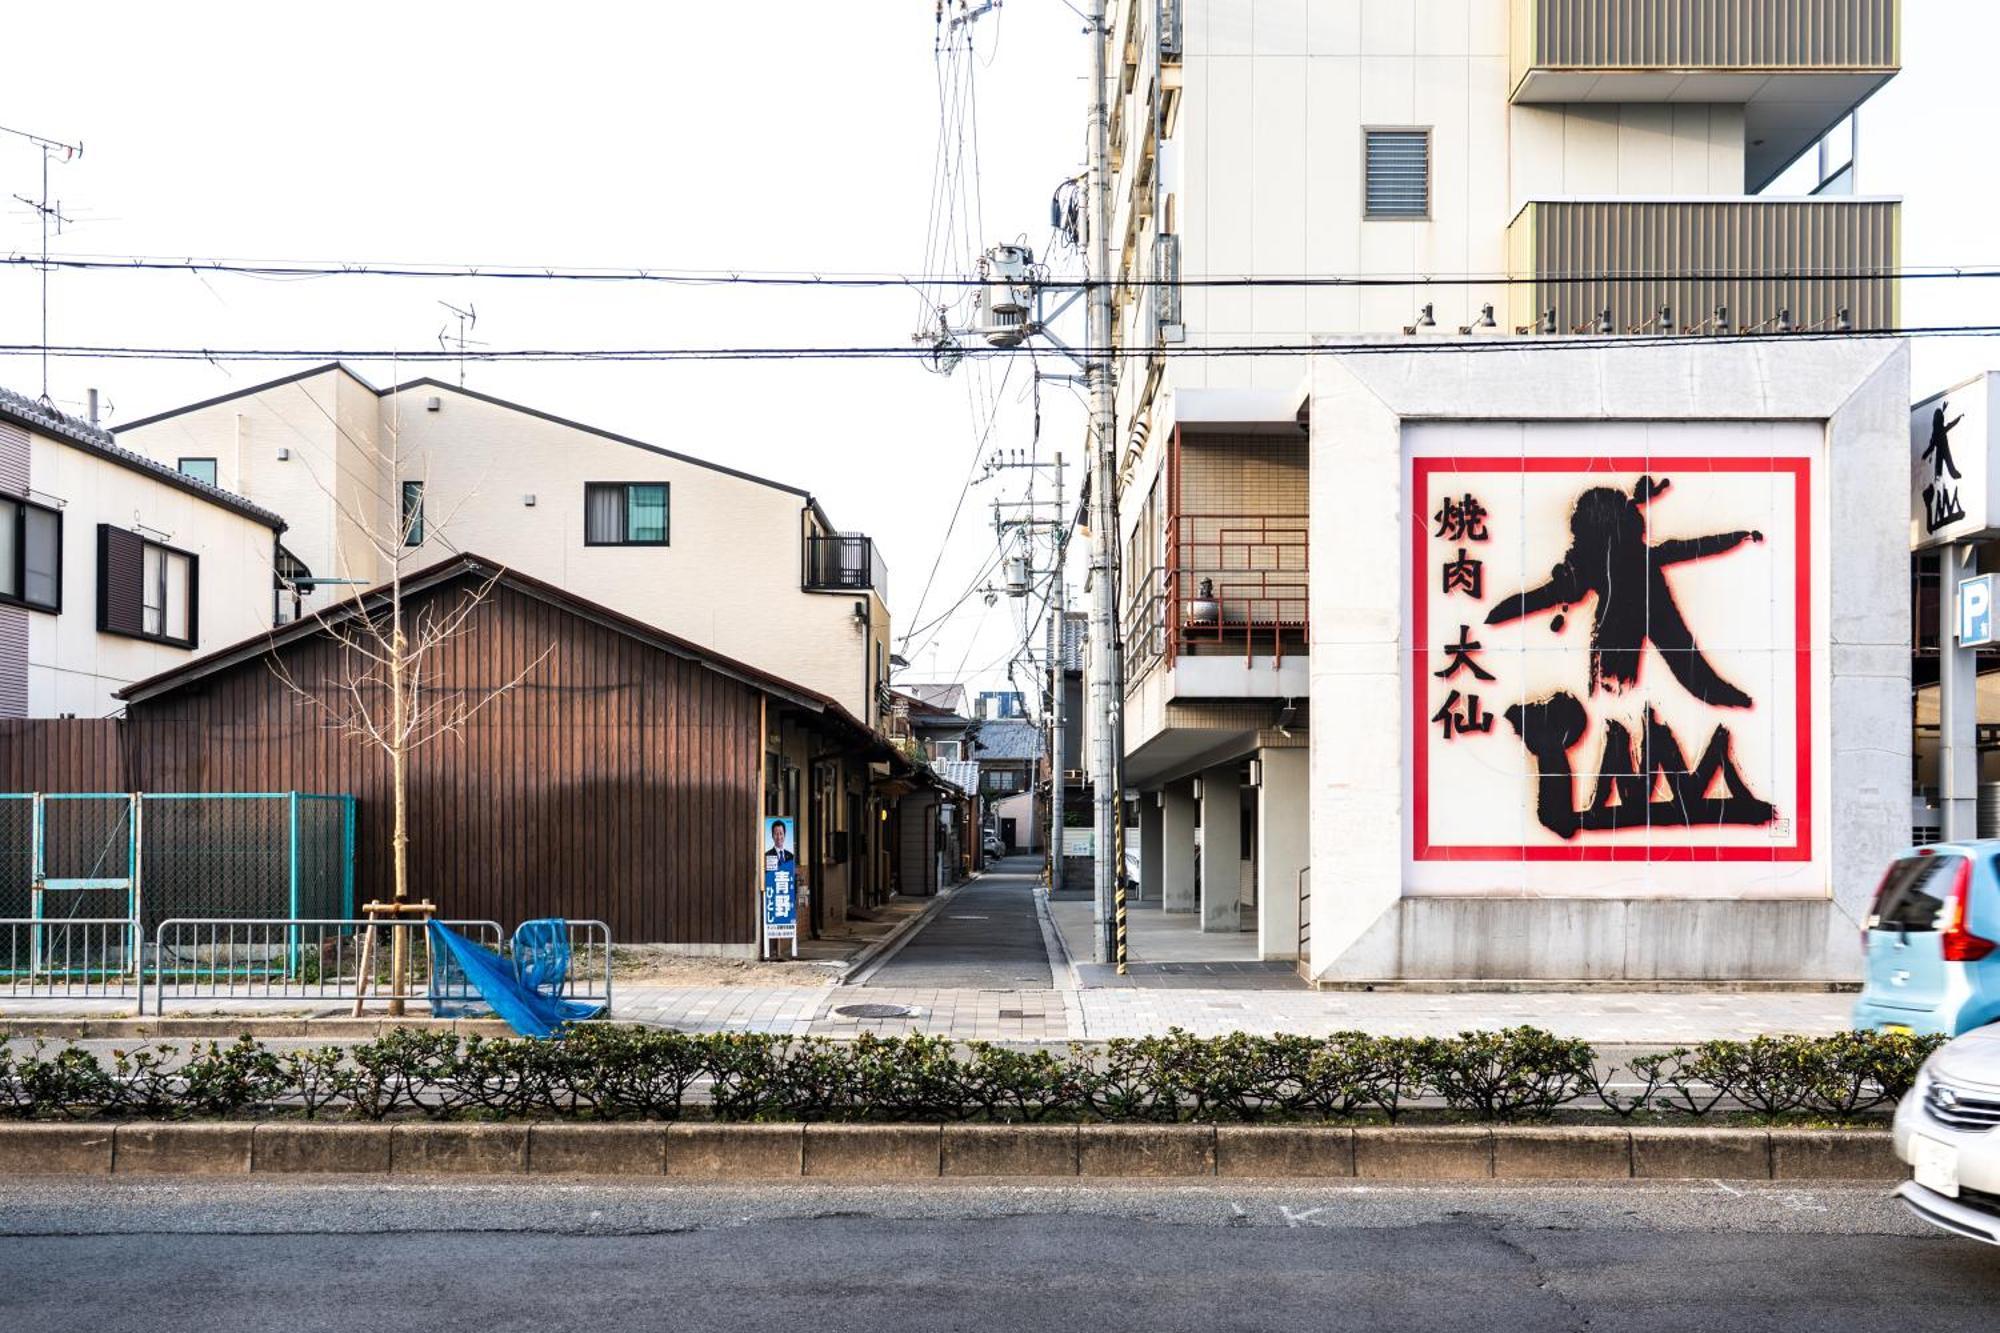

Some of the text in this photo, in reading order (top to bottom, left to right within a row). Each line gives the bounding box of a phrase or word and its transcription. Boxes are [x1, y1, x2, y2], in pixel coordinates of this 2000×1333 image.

[1431, 493, 1497, 740] 焼肉 大仙
[1963, 583, 1989, 638] P
[766, 886, 775, 923] ひとし
[774, 870, 791, 918] 青野
